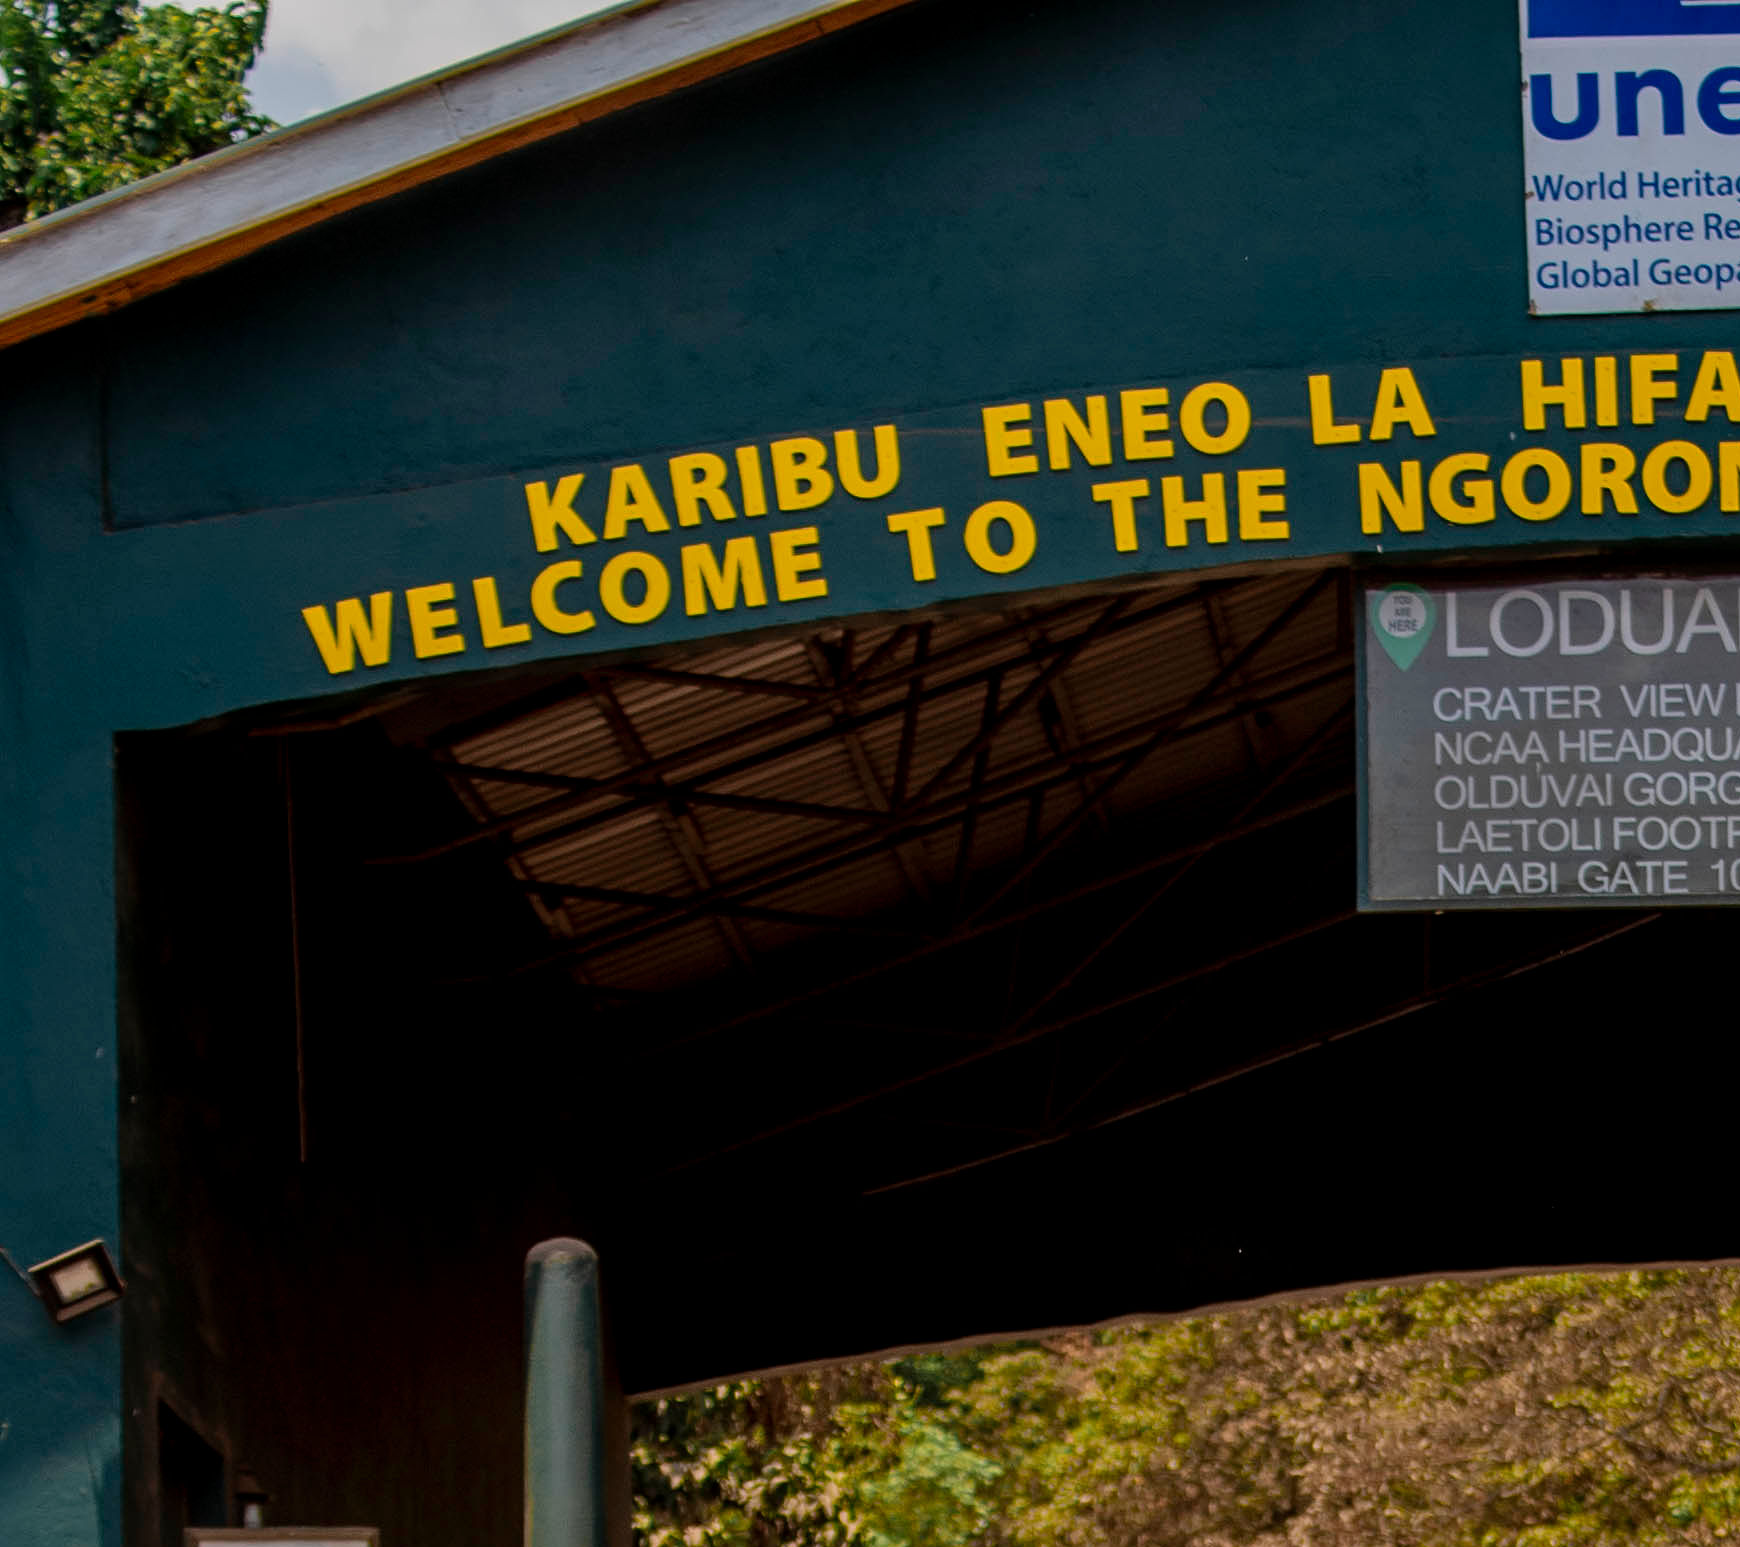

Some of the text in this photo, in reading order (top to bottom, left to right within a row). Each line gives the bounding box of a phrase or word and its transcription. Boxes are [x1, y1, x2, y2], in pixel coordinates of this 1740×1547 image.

[1532, 171, 1627, 202] World
[1535, 215, 1694, 251] Biosphere
[1537, 258, 1639, 289] Global
[525, 425, 899, 552] KARIBU
[982, 382, 1251, 476] ENEO
[1309, 368, 1437, 445] LA
[302, 527, 828, 674] WELCOME
[888, 501, 1037, 581] TO
[1092, 469, 1290, 552] THE
[1433, 685, 1602, 721] CRATER
[1619, 683, 1726, 718] VIEW
[1434, 731, 1550, 766] NCAA
[1434, 773, 1613, 810] OLDUVAI
[1436, 817, 1601, 854] LAETOLI
[1437, 861, 1558, 895] NAABI
[1577, 860, 1689, 894] GATE
